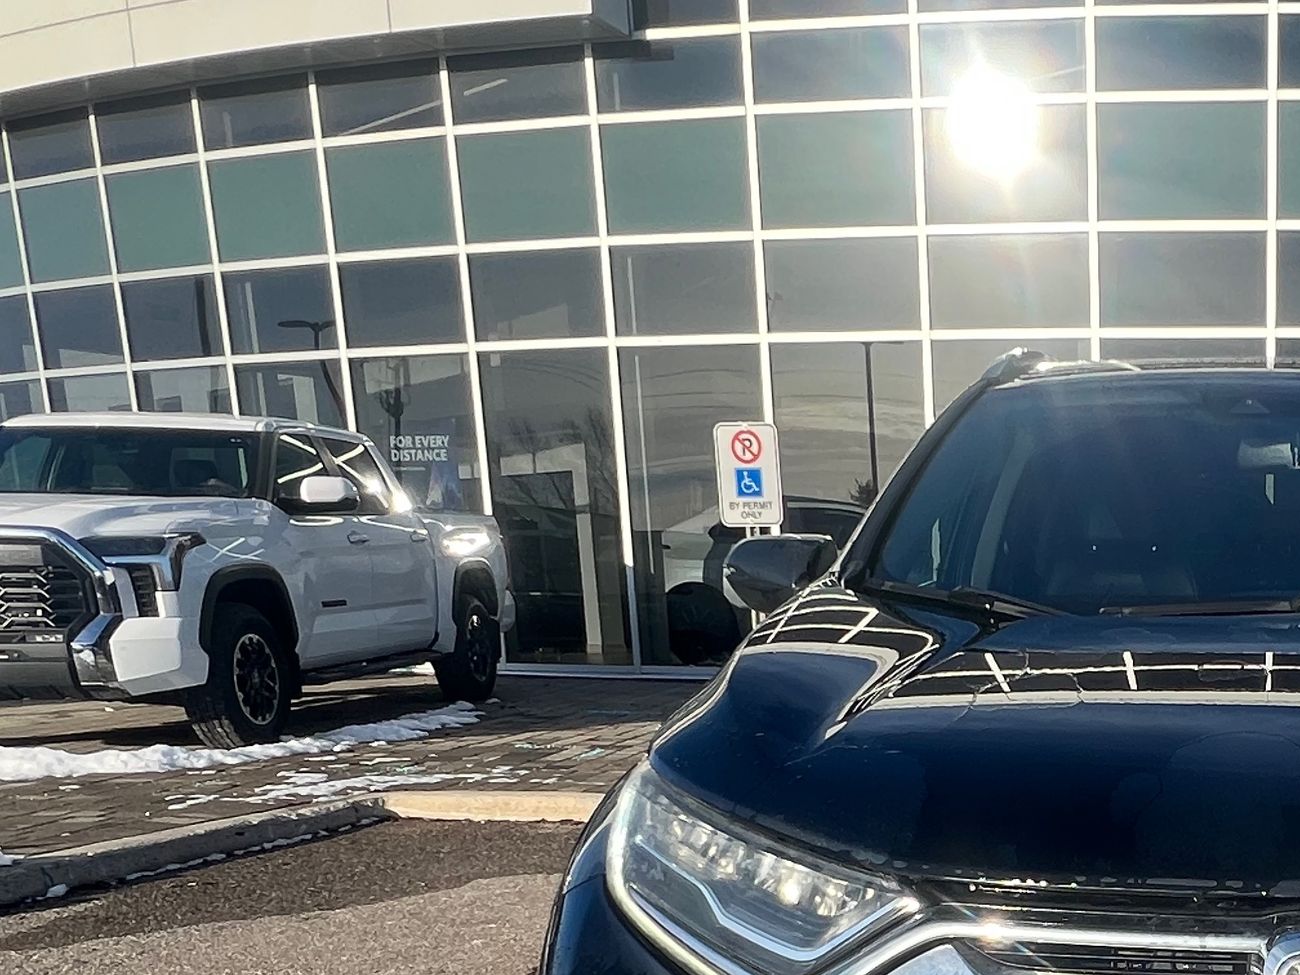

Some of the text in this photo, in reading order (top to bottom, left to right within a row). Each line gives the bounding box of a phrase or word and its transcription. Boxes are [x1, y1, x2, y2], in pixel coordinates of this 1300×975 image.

[390, 435, 449, 448] FOR EVERY
[391, 449, 448, 462] DISTANCE
[729, 501, 773, 510] BY PERMIT
[741, 511, 762, 520] ONLY
